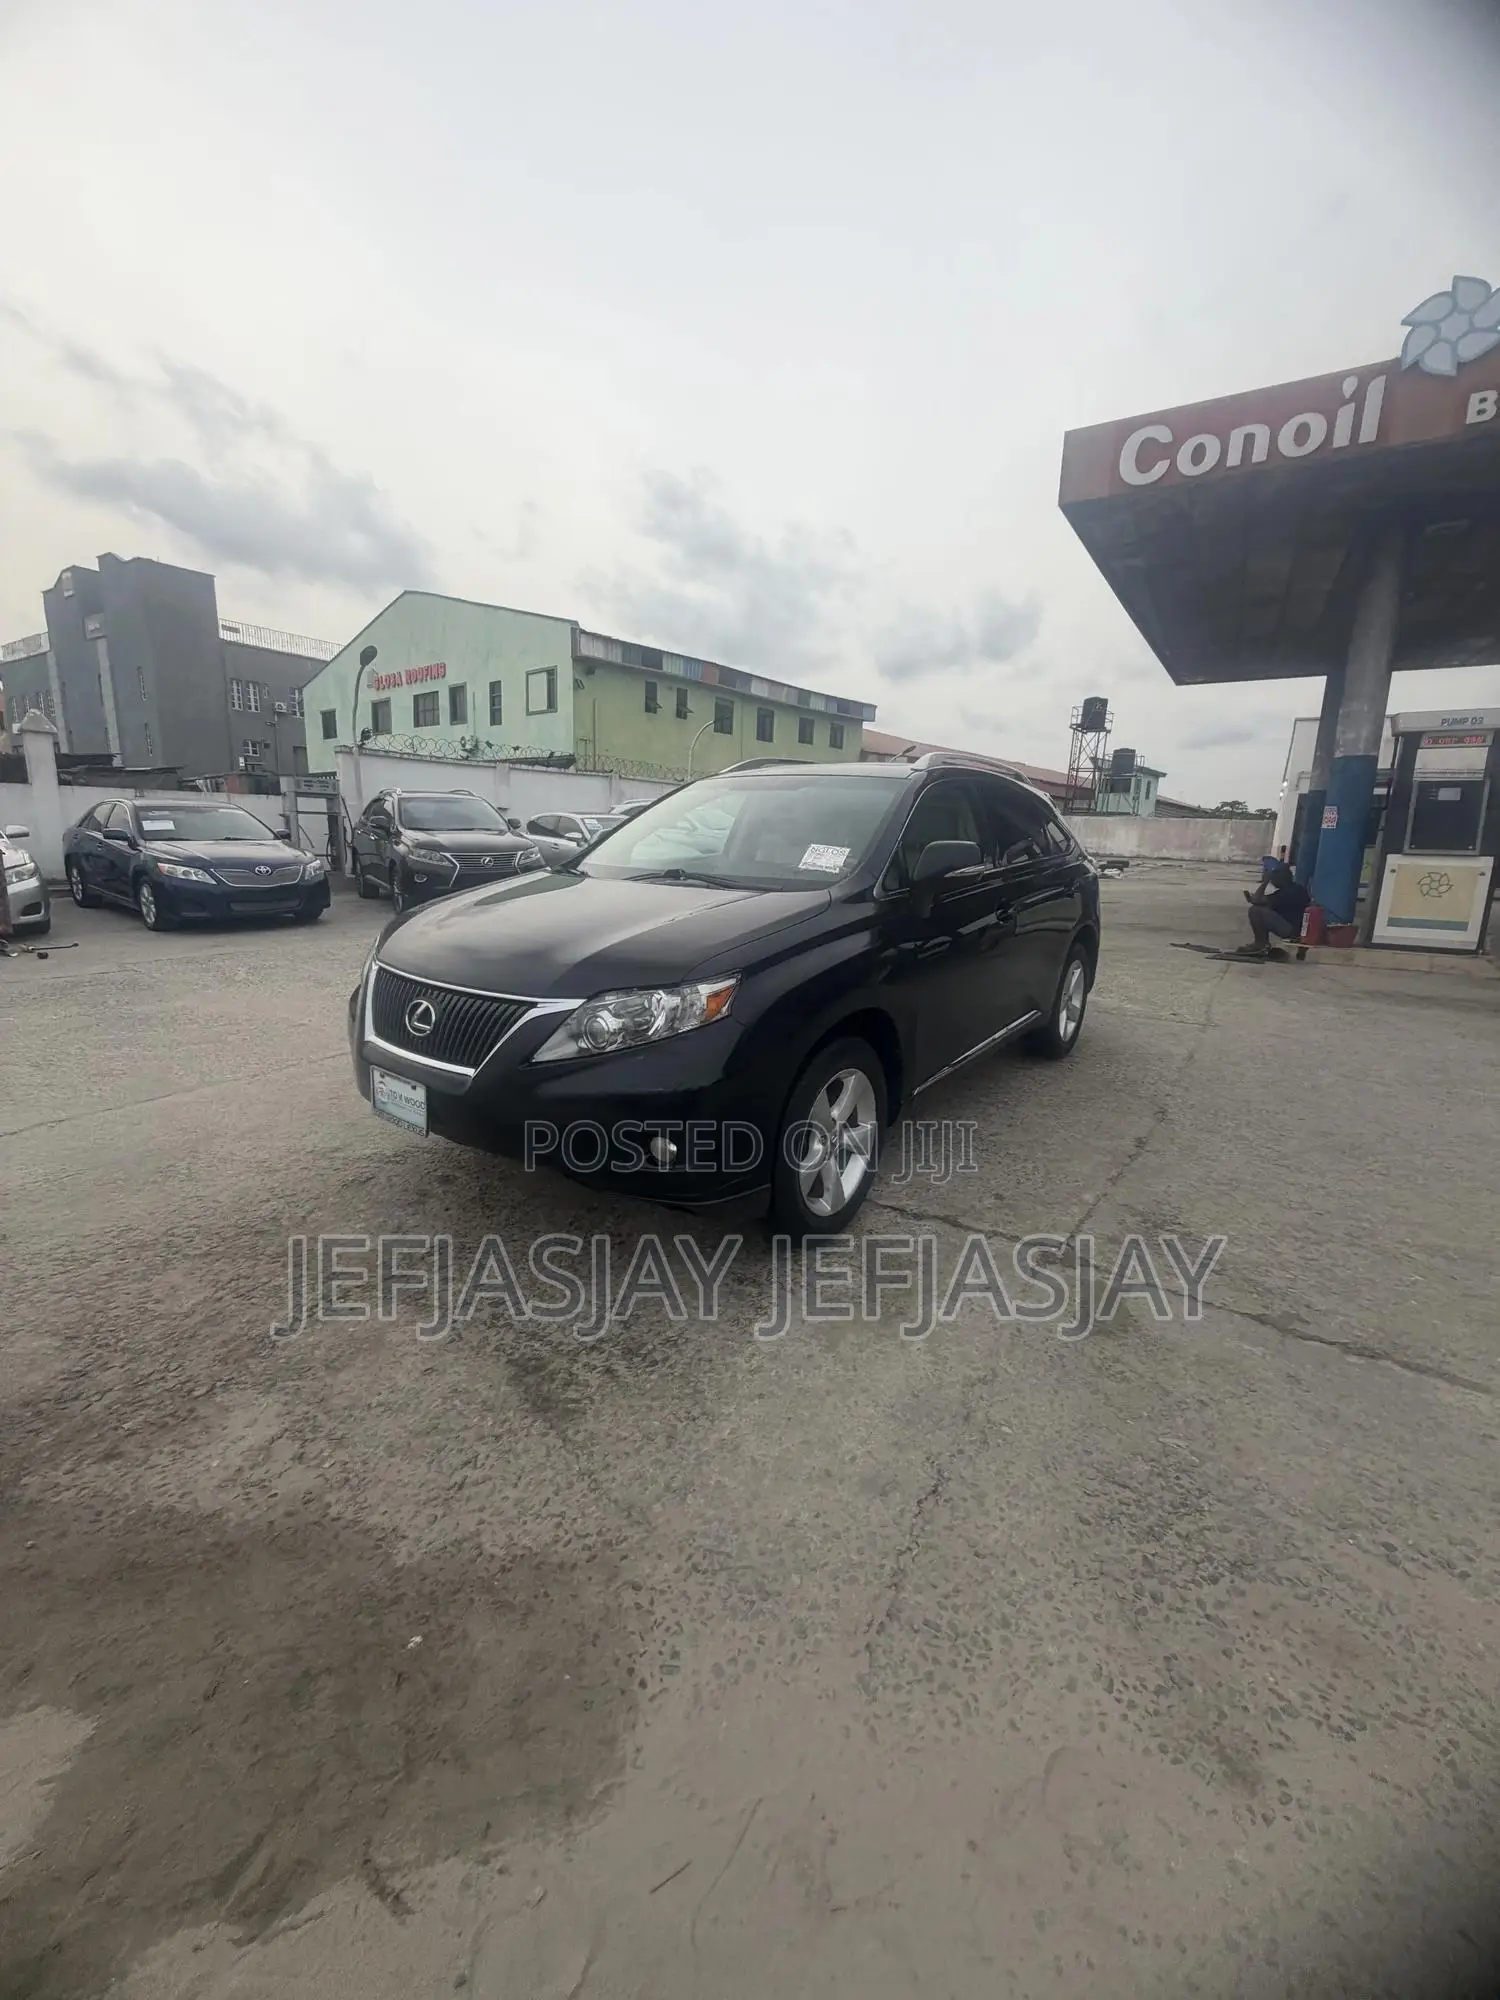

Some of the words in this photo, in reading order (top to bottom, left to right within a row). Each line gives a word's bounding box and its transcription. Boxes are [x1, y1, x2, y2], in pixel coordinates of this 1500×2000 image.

[1466, 390, 1498, 424] B
[1119, 375, 1386, 486] Conoil
[1441, 716, 1469, 726] PUMP
[404, 1094, 425, 1110] WOOD
